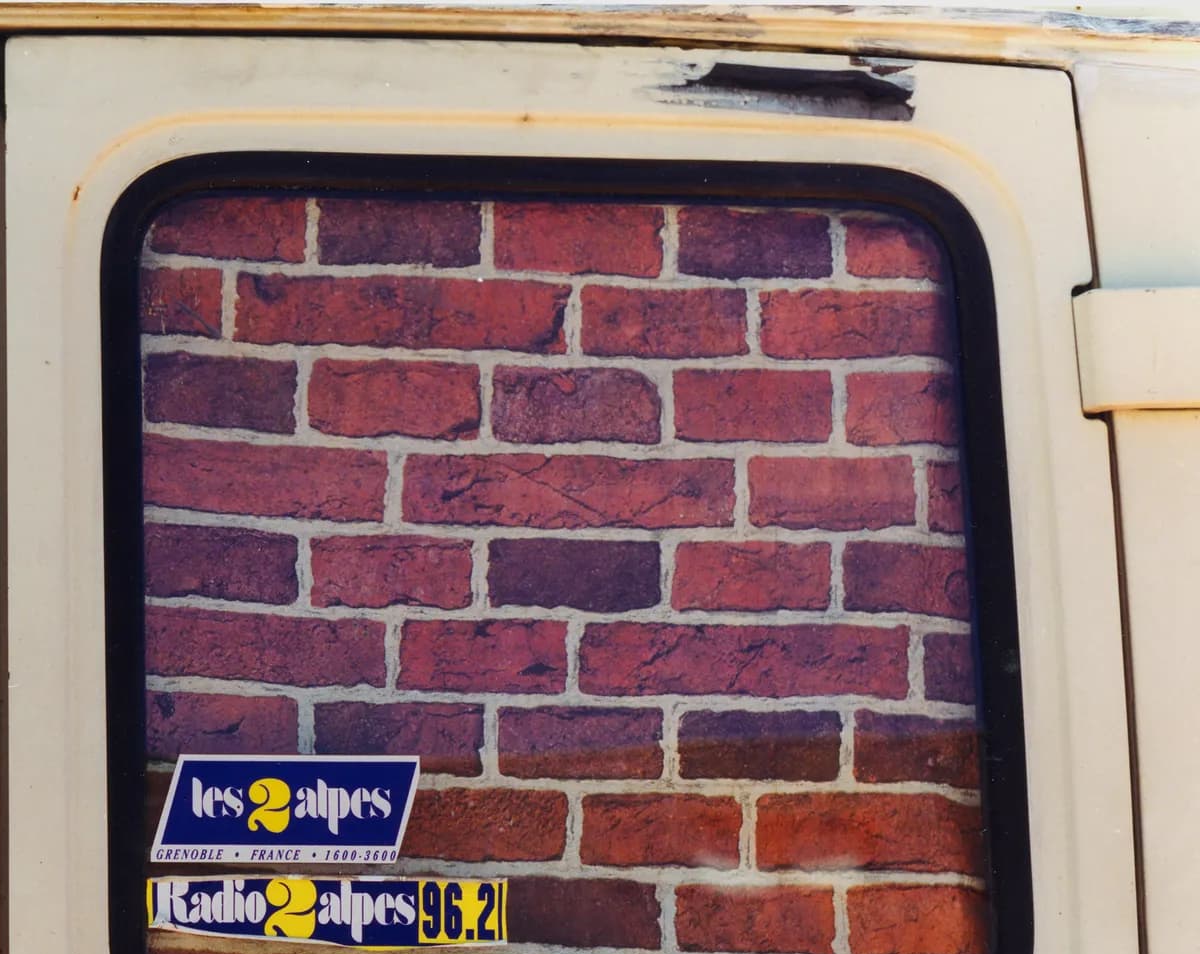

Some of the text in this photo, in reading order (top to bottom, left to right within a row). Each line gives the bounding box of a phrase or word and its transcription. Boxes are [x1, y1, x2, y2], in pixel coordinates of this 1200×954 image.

[191, 777, 392, 836] les 2 alpes
[155, 848, 224, 861] GRENOBLE
[250, 849, 301, 862] FRANCE
[155, 879, 496, 944] Radio 2 alpes 96.2
